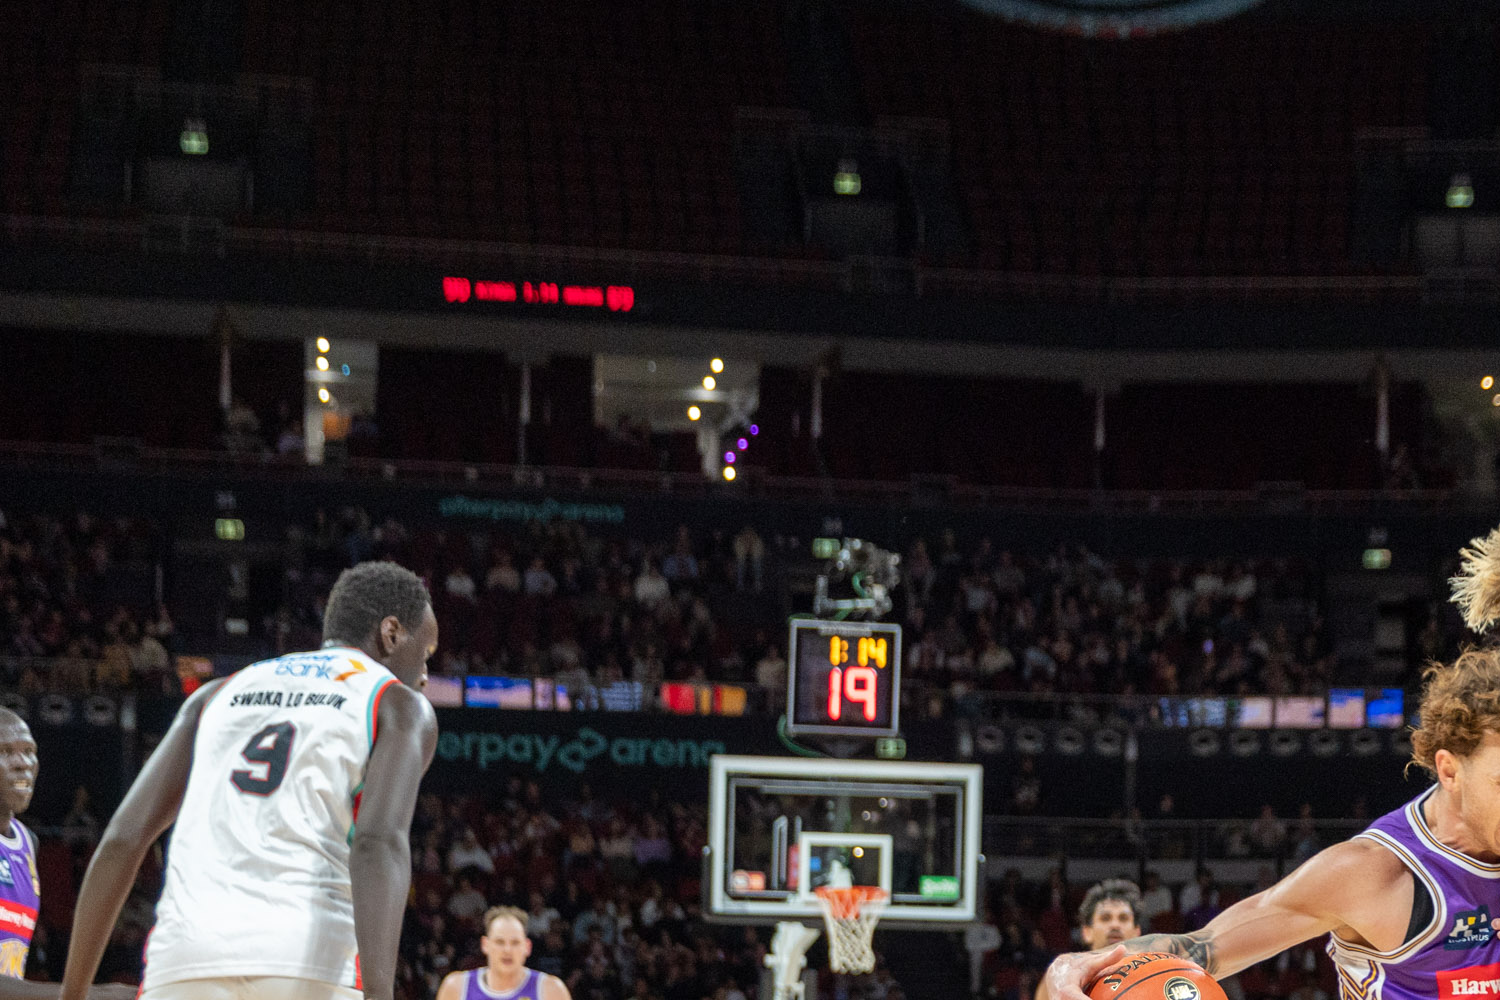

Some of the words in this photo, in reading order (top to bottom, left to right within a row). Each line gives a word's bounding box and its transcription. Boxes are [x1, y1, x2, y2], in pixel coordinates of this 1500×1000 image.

[829, 634, 888, 670] 1:14
[230, 690, 284, 709] SWAKA
[286, 691, 302, 709] LO
[827, 665, 878, 722] 19
[229, 719, 297, 797] 9
[438, 732, 559, 771] erpay
[1102, 952, 1181, 992] SPALD
